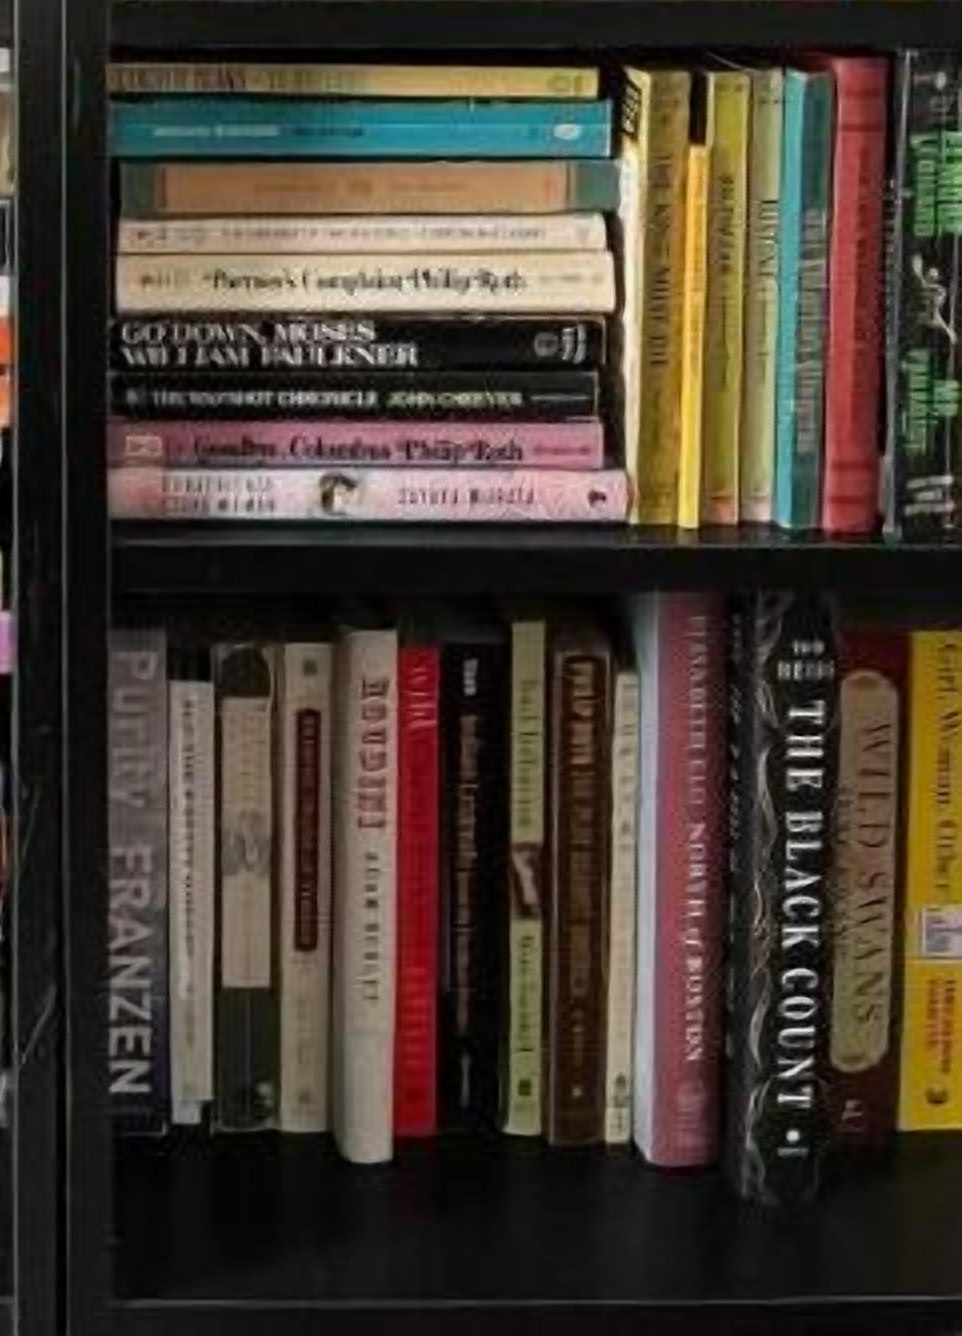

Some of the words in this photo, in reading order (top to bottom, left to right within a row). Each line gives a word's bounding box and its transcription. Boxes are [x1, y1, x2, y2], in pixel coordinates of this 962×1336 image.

[786, 700, 826, 793] THE
[855, 720, 891, 850] WILD
[780, 810, 823, 951] BLACK
[849, 866, 888, 1024] SWANS
[107, 846, 152, 1095] FRANZEN
[776, 966, 820, 1111] COUNT
